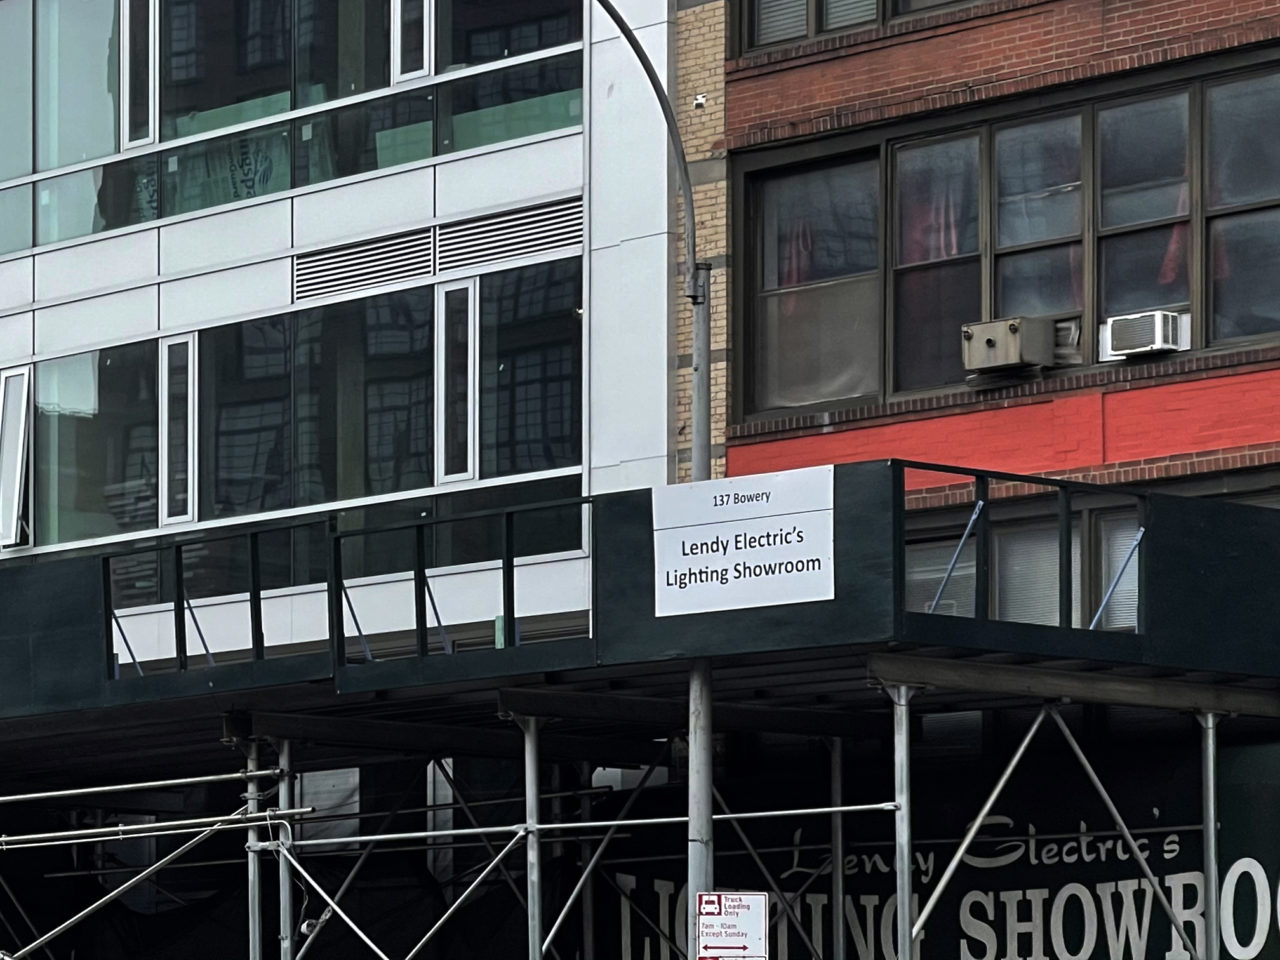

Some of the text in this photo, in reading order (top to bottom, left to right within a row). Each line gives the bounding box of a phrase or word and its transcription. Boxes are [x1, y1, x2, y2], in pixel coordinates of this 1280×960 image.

[713, 491, 771, 507] 137 Bowery
[681, 526, 804, 557] Lendy Electric's
[666, 557, 821, 589] Lighting Showroom
[724, 903, 751, 911] Loading
[959, 857, 1280, 960] SHOWRO
